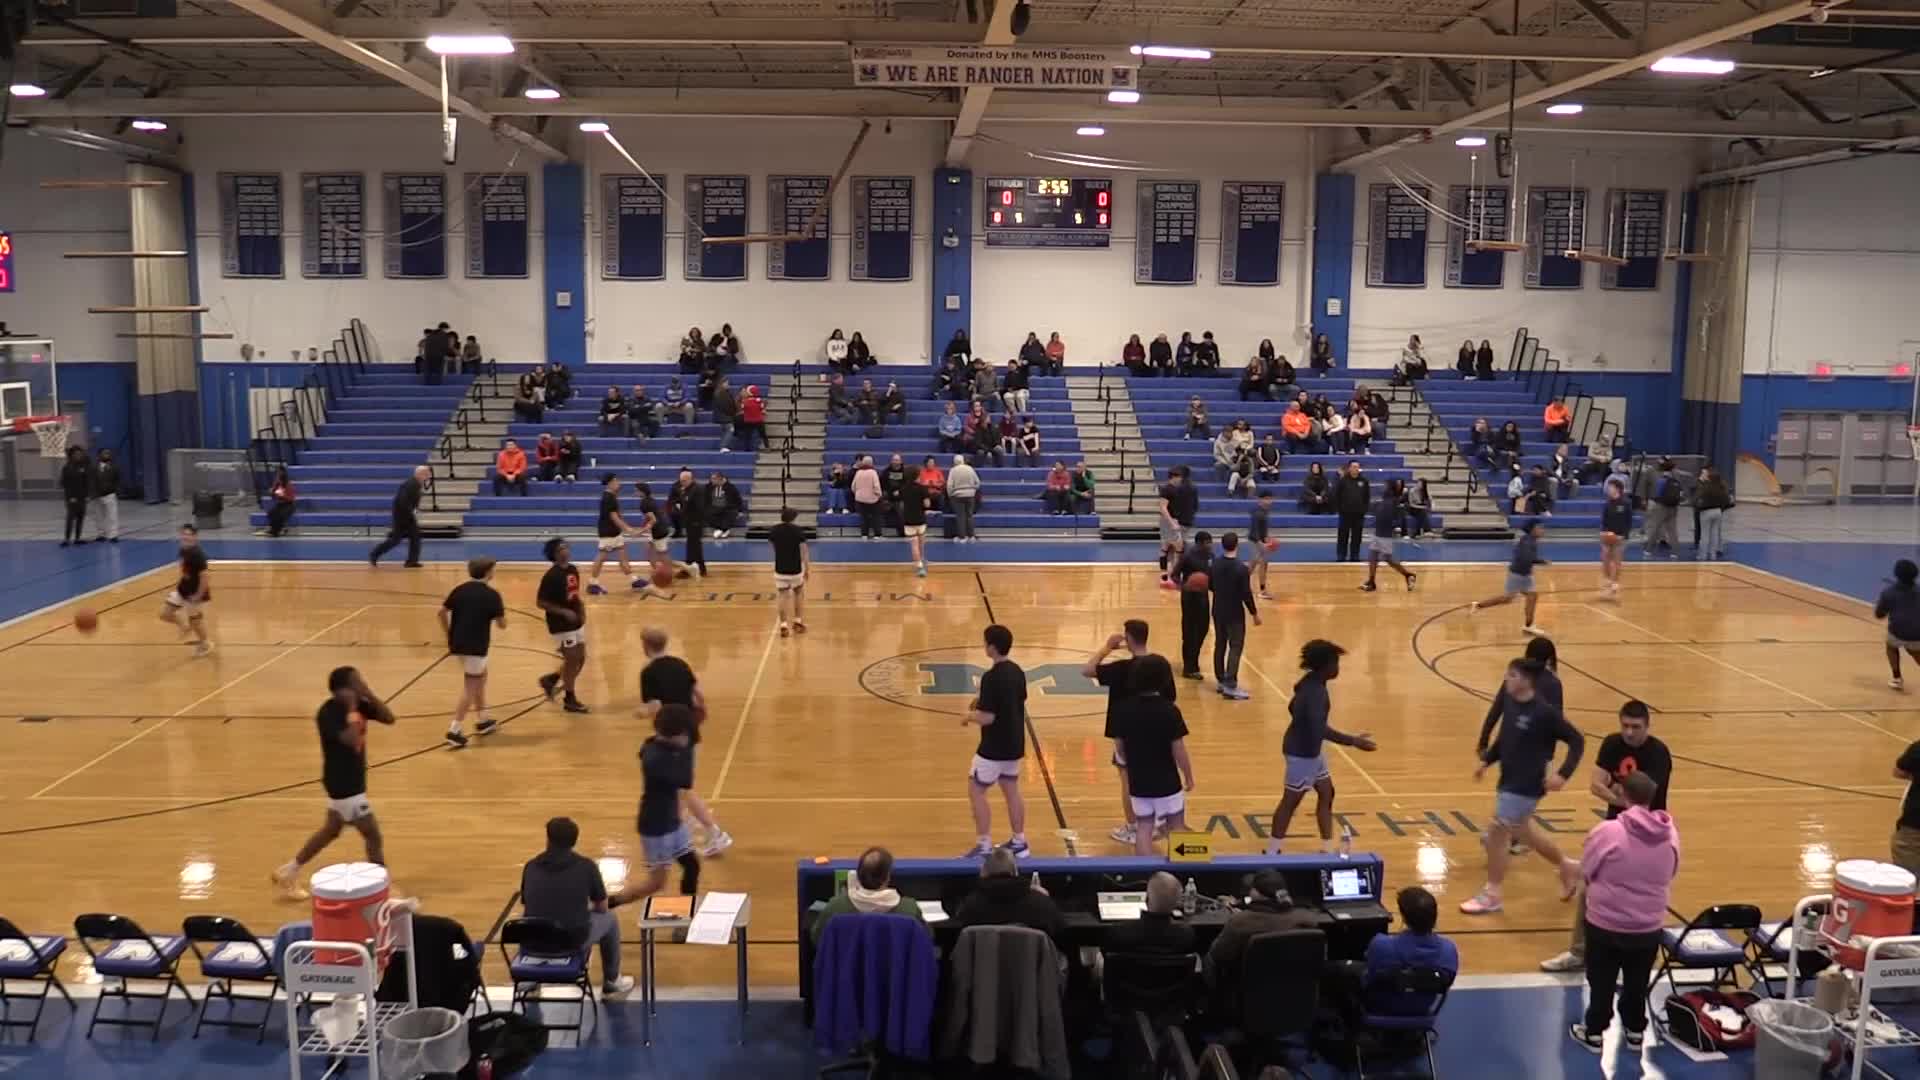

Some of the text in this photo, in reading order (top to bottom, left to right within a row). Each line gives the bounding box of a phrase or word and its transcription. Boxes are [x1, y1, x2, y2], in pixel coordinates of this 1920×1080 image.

[947, 49, 1106, 62] Donated by the MHS Boosters
[887, 65, 918, 82] WE
[926, 66, 960, 83] ARE
[966, 66, 1034, 84] RANGER
[1041, 67, 1105, 85] NATION
[1039, 179, 1069, 194] 2:55
[1002, 190, 1012, 206] 0
[1098, 191, 1108, 207] 0
